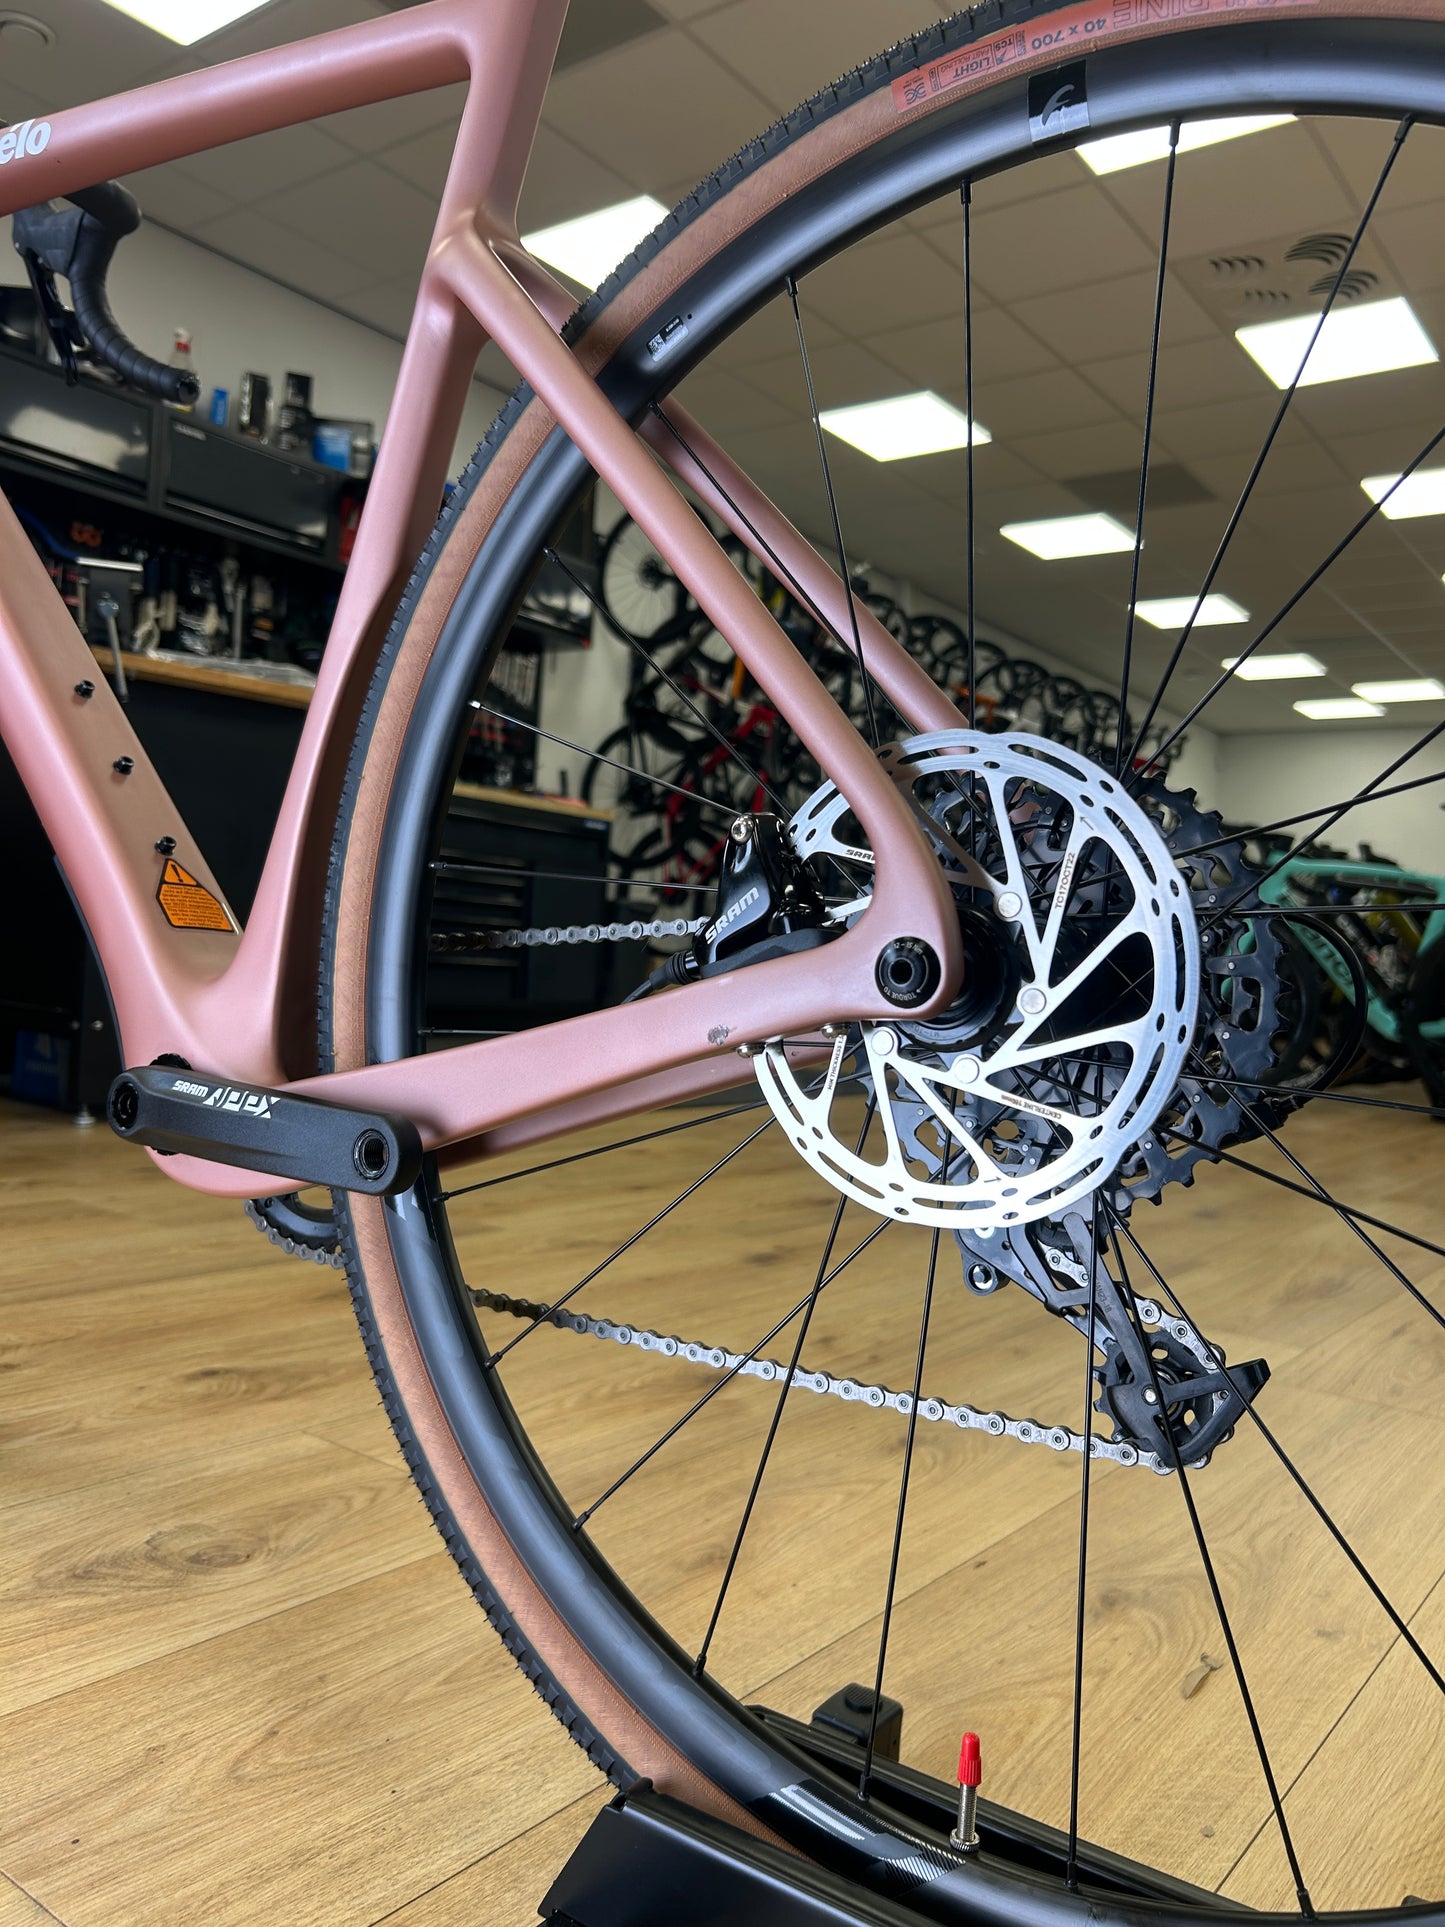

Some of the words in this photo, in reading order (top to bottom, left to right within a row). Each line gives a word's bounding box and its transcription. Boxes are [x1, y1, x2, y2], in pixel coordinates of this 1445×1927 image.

[1084, 18, 1107, 33] 40
[1031, 30, 1065, 50] 700
[953, 57, 990, 79] LIGHT
[705, 887, 760, 945] SRAM
[891, 991, 917, 1001] TORQUE
[171, 1080, 208, 1097] SRAM
[1023, 1101, 1062, 1119] CENTERLINE
